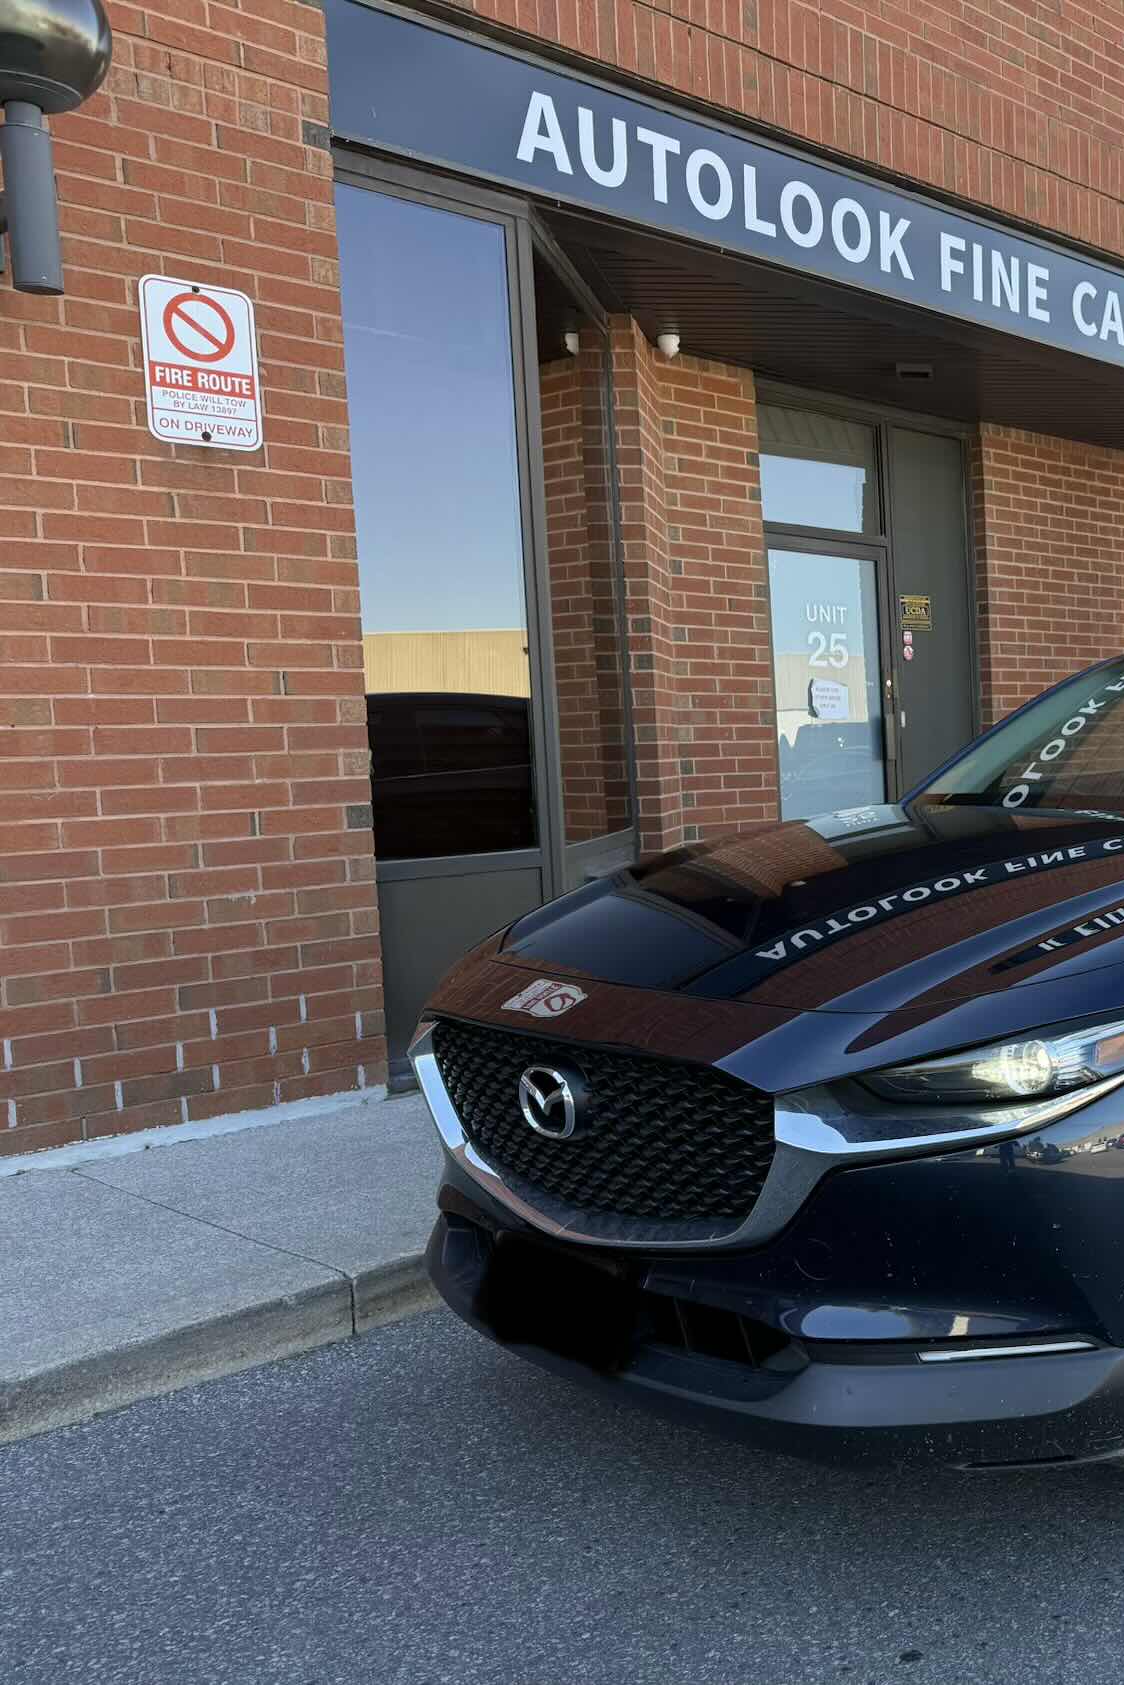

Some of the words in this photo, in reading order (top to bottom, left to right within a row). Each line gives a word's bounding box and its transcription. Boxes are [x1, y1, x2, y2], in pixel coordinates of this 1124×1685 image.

[516, 91, 914, 281] AUTOLOOK
[940, 232, 1051, 323] FINE
[155, 366, 193, 387] FIRE
[197, 372, 252, 395] ROUTE
[162, 389, 198, 402] POLICE
[200, 395, 223, 406] WILL
[224, 398, 247, 408] TOW
[173, 400, 185, 409] BY
[188, 402, 209, 412] LAW
[159, 417, 180, 430] ON
[184, 420, 253, 438] DRIVEWAY
[806, 604, 847, 625] UNIT
[807, 631, 849, 668] 25
